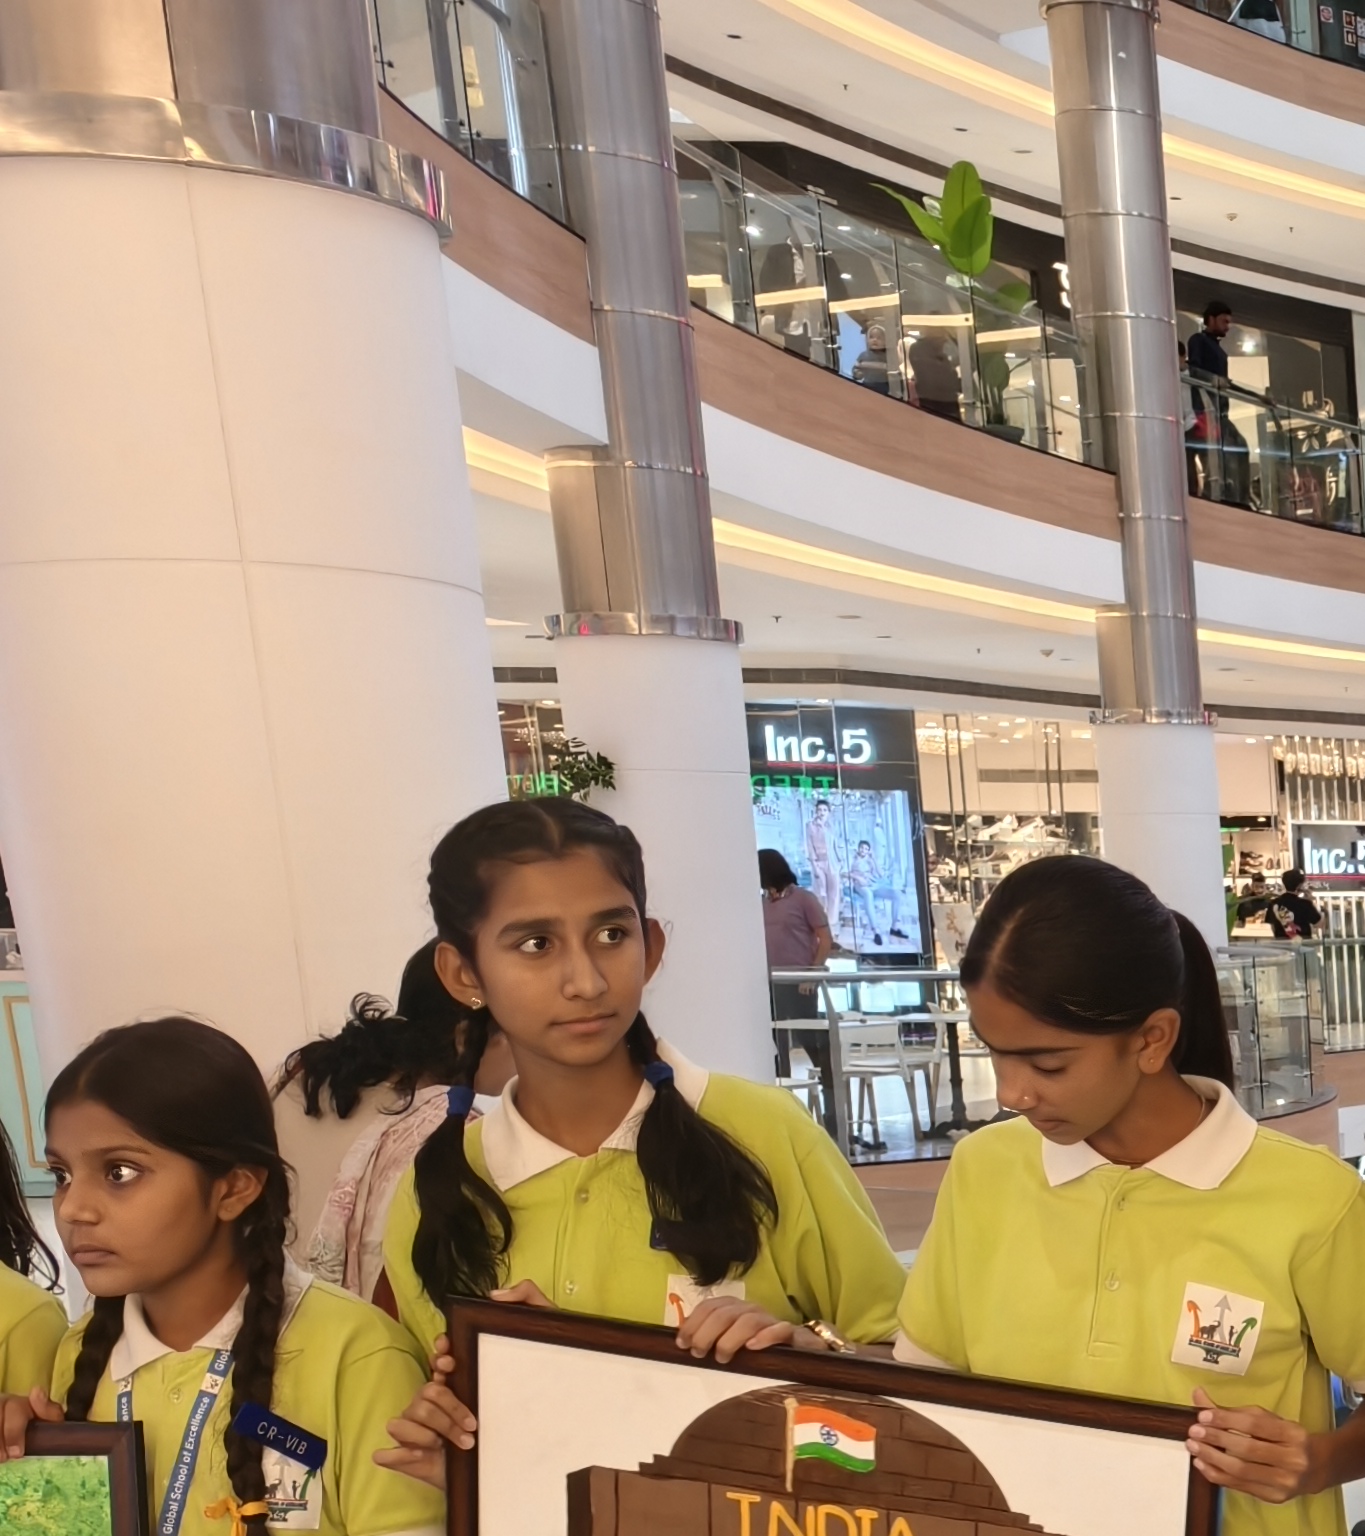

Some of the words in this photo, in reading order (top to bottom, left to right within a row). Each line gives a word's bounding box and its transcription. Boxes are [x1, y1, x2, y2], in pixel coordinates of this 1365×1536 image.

[184, 1396, 210, 1450] Excellence
[182, 1450, 192, 1463] of
[171, 1463, 189, 1500] School
[162, 1506, 180, 1535] Global
